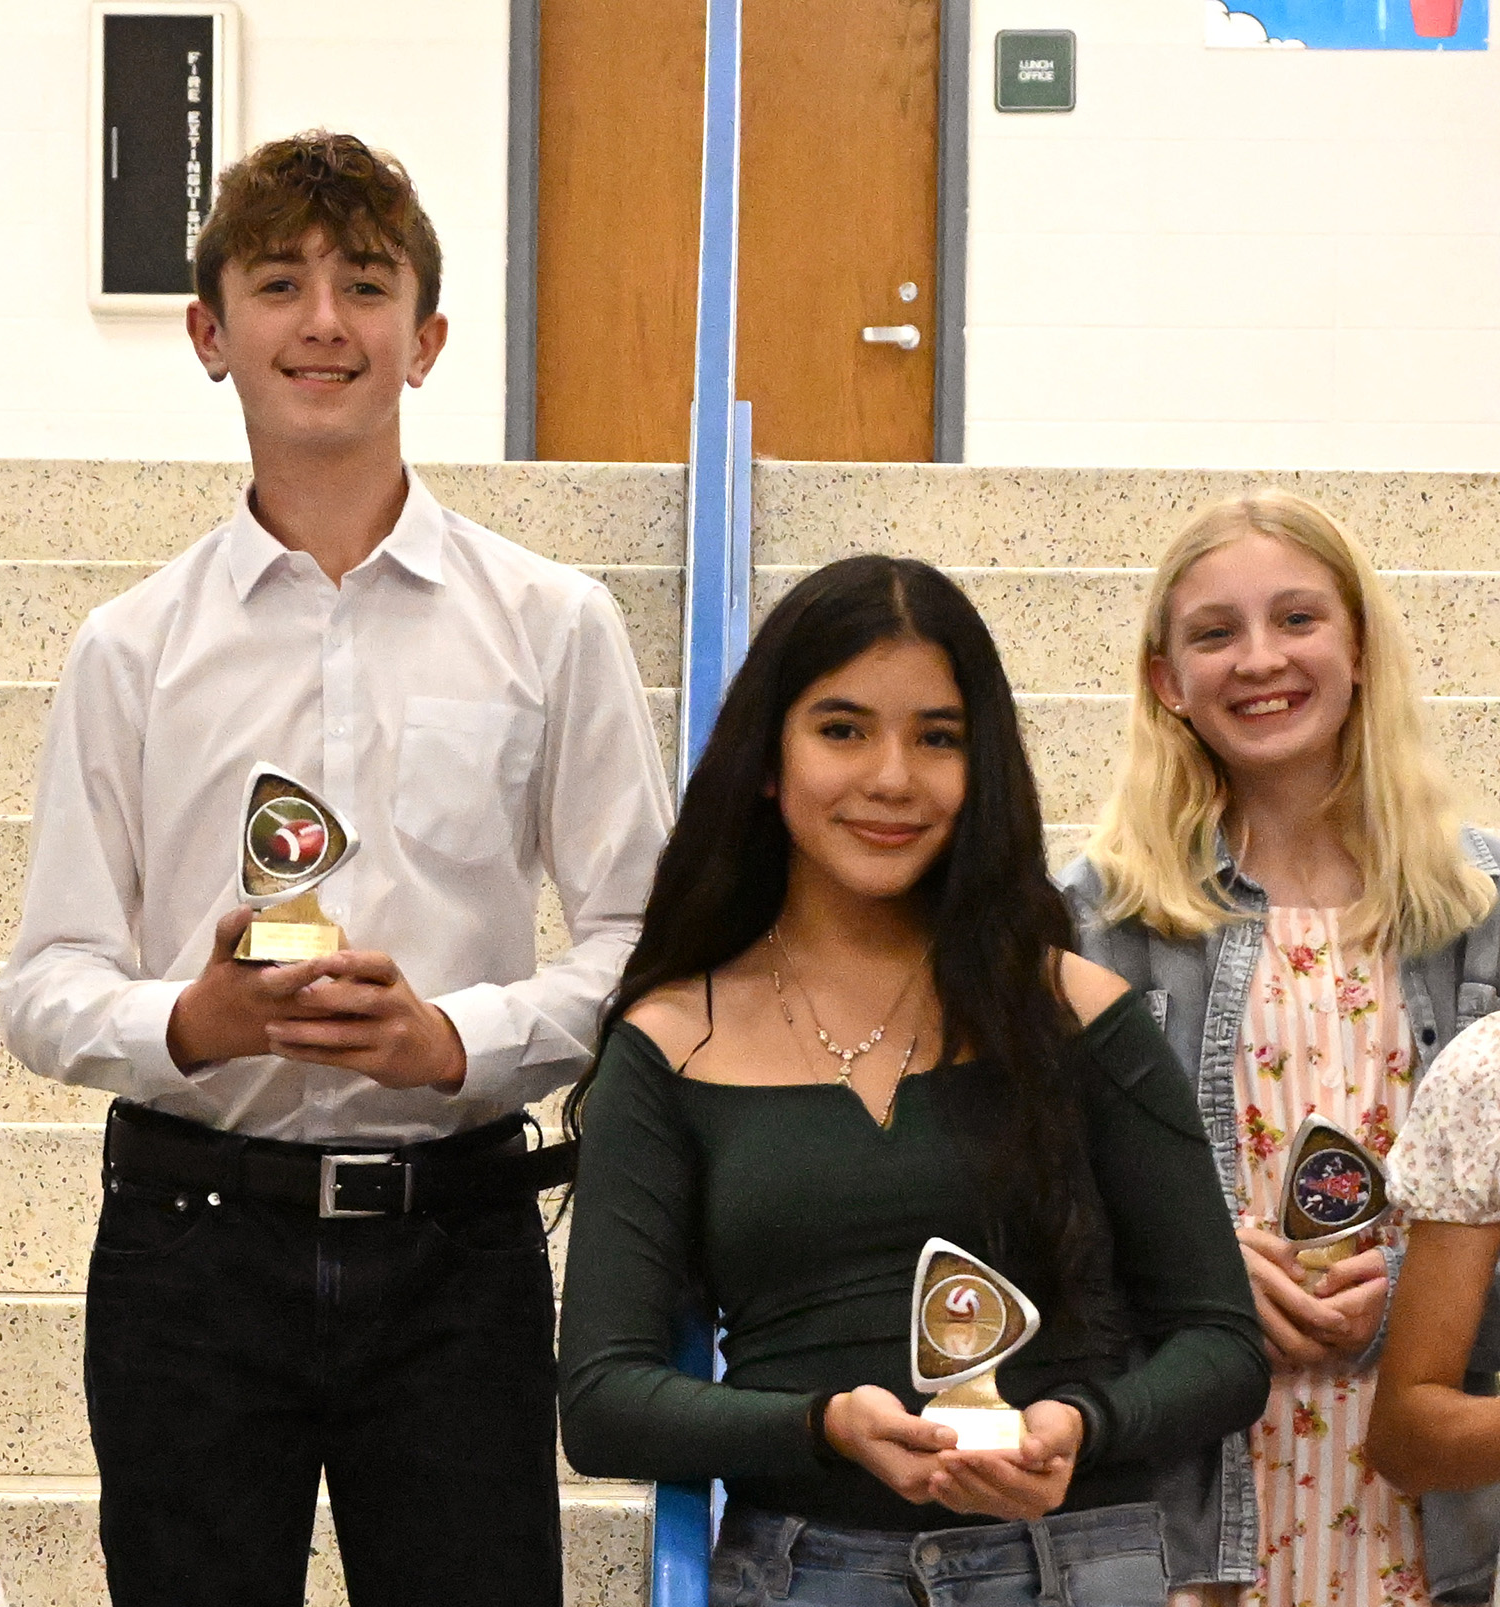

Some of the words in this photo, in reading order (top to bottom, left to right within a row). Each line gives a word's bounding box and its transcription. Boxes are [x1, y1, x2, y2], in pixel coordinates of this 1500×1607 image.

[1019, 59, 1054, 69] LUNCH
[187, 51, 202, 103] FIRE
[1018, 70, 1055, 81] OFFICE
